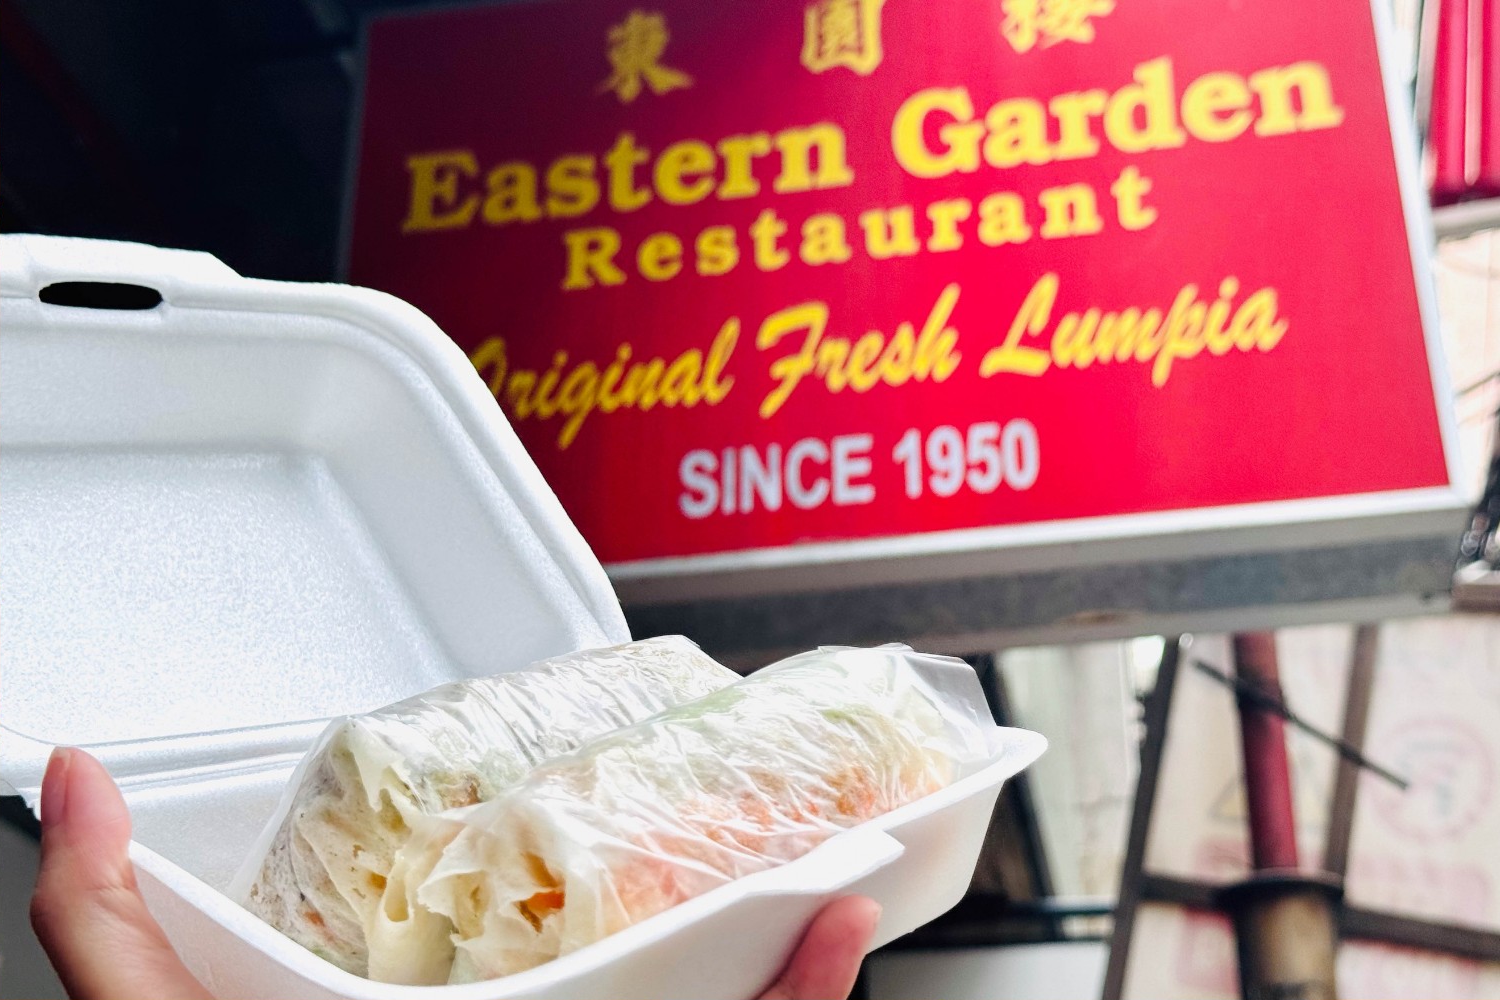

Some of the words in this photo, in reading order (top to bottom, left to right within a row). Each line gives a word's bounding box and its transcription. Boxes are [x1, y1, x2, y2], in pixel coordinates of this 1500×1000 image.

[402, 122, 855, 233] Eastern
[891, 55, 1344, 179] Garden
[562, 165, 1158, 290] Restaurant
[756, 283, 962, 418] Fresh
[979, 272, 1289, 388] Lumpia
[679, 433, 876, 518] SINCE
[892, 417, 1040, 499] 1950
